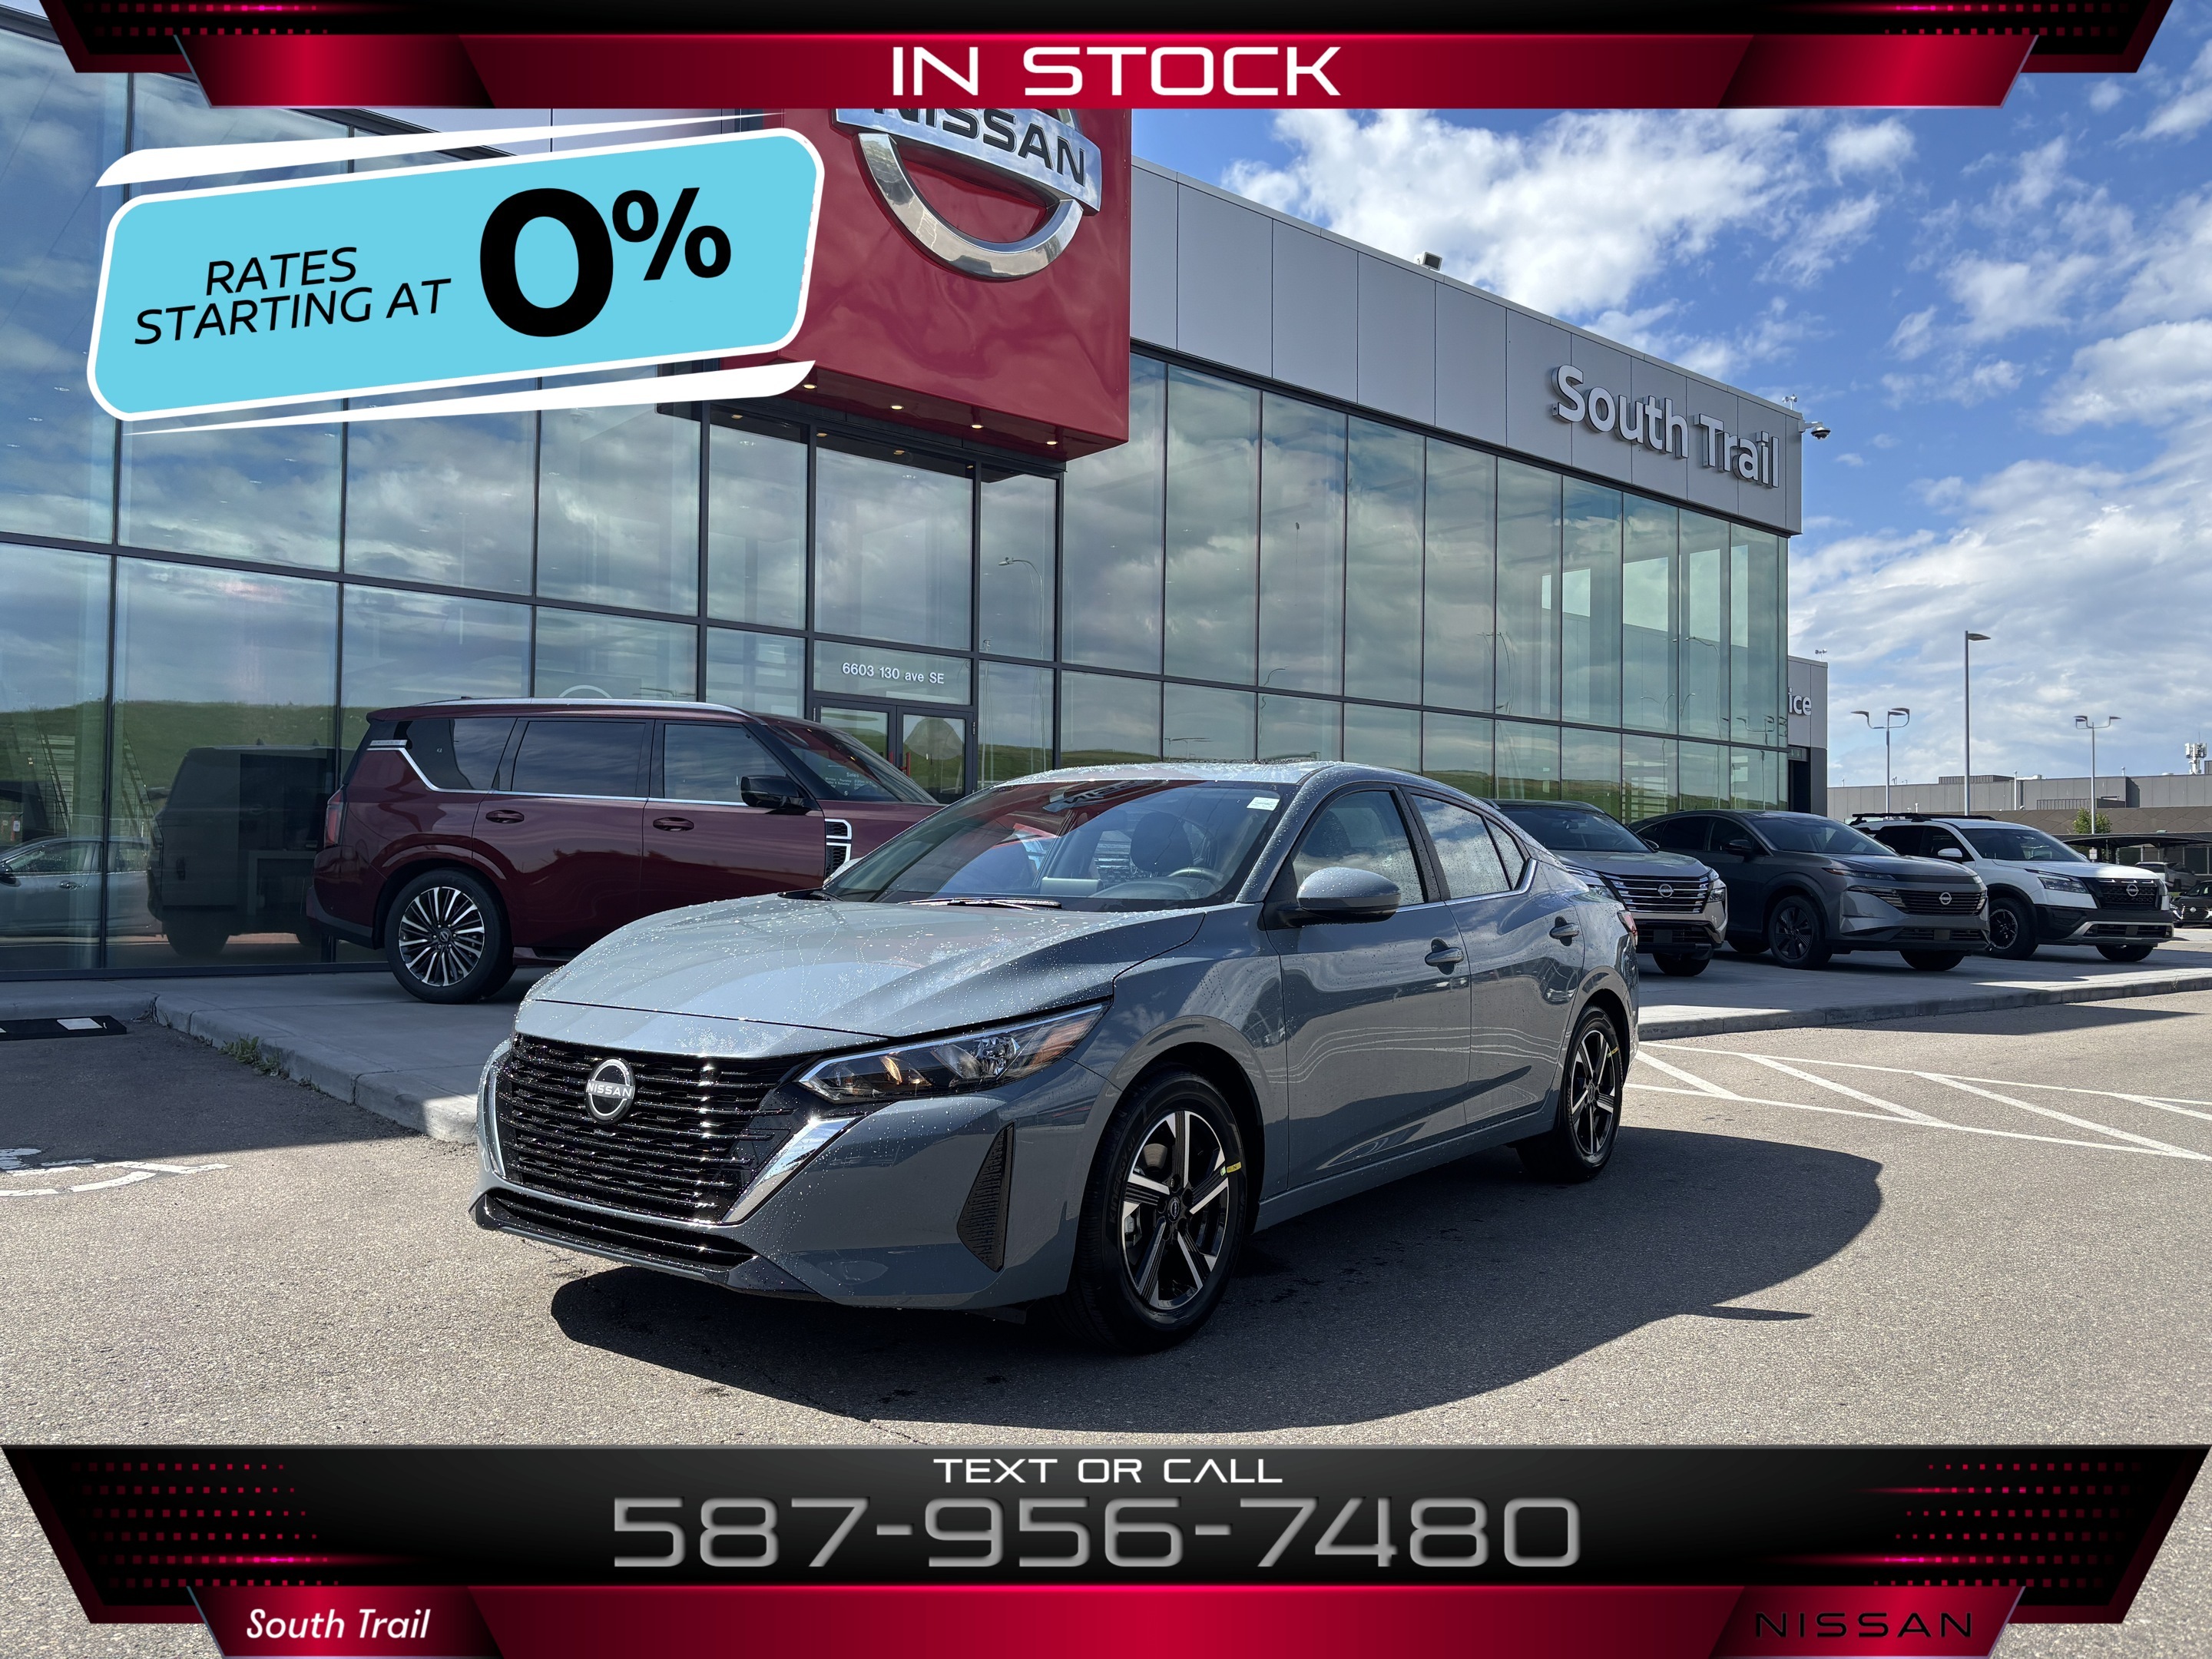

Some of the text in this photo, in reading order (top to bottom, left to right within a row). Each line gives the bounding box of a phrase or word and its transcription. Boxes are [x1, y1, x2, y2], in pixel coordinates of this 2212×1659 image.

[1552, 364, 1780, 488] South Trail
[842, 662, 945, 684] 6603 130 ave SE
[587, 1081, 632, 1098] NISSAN
